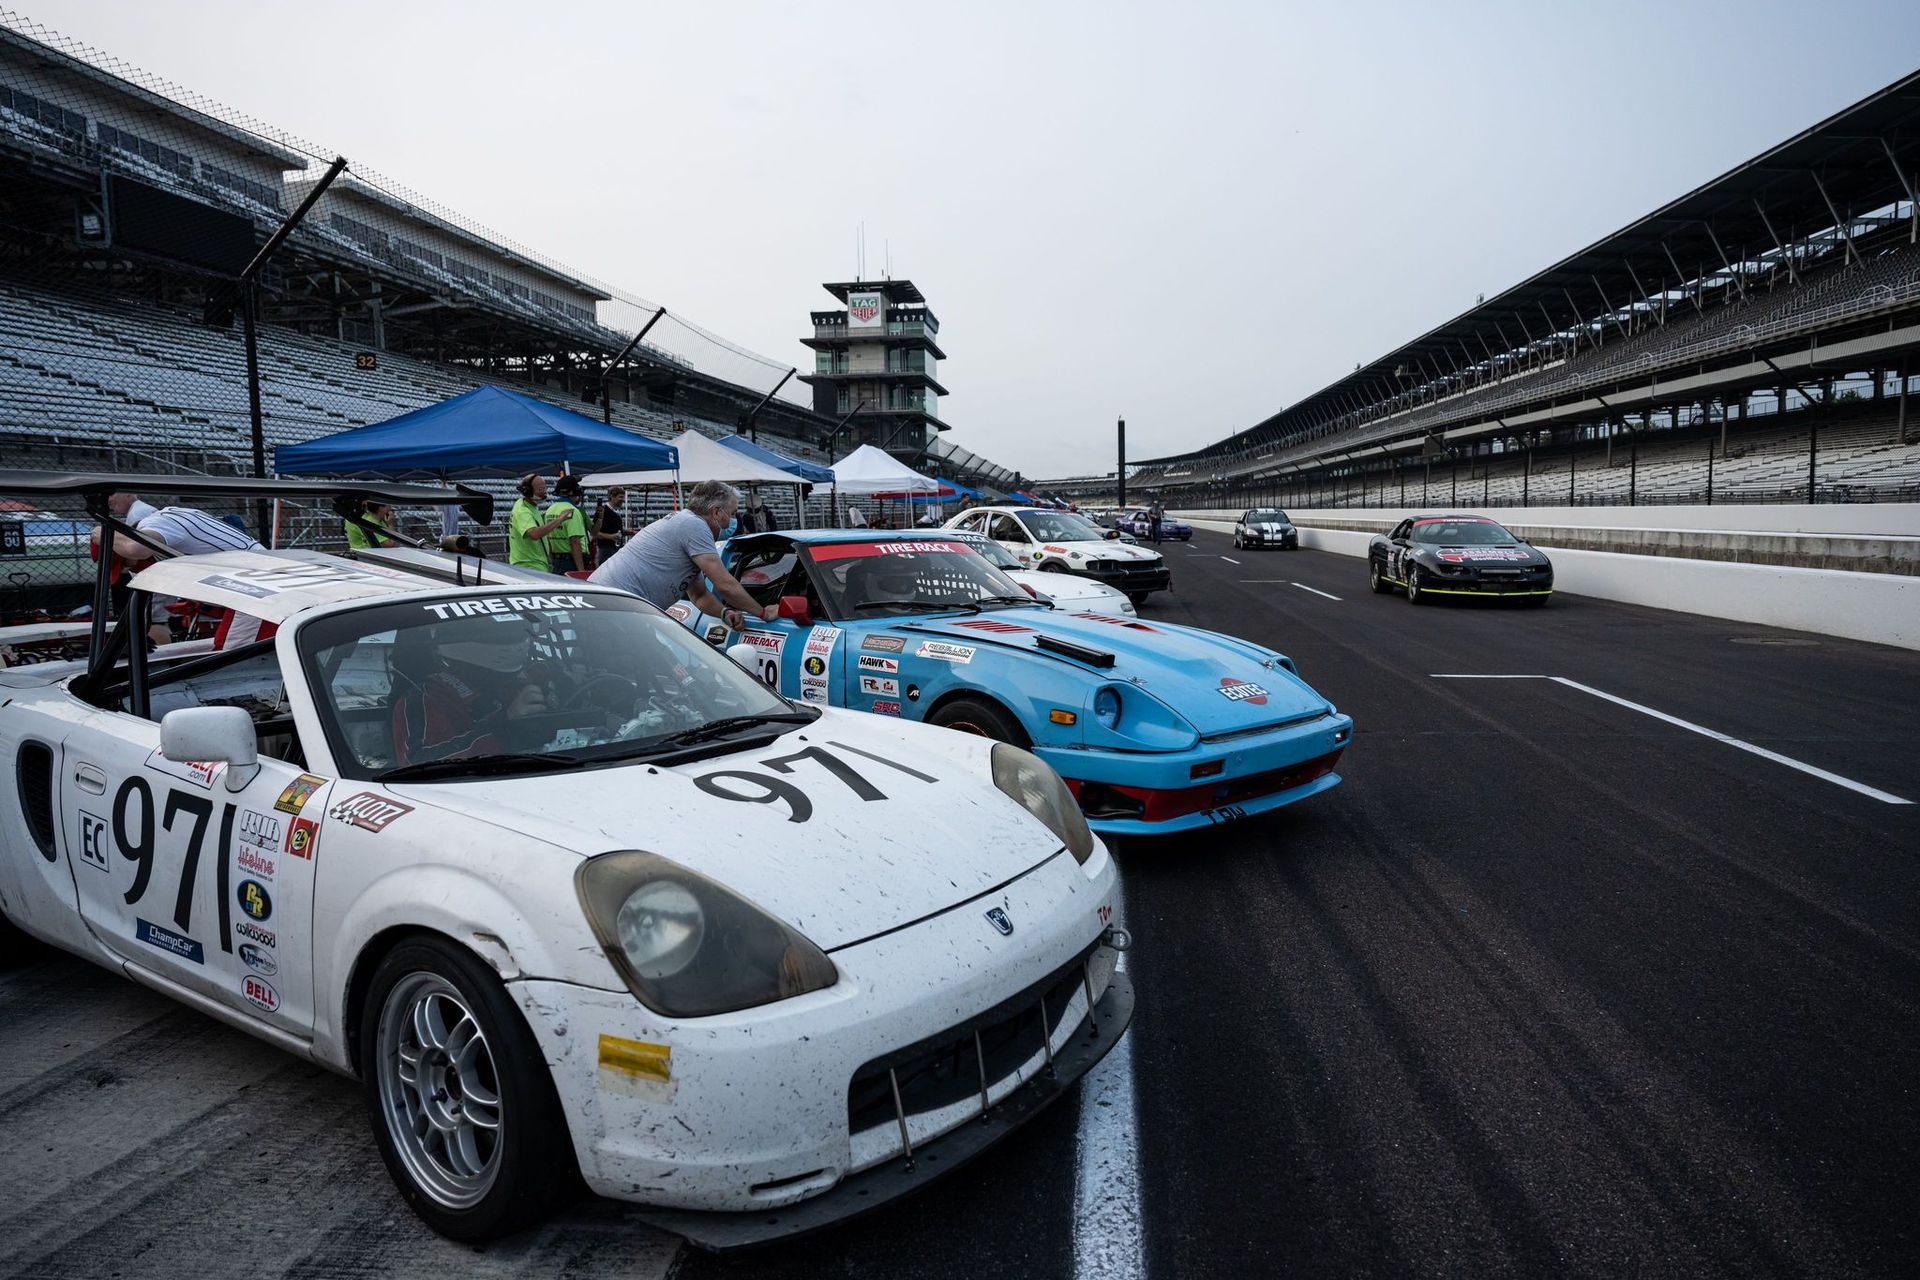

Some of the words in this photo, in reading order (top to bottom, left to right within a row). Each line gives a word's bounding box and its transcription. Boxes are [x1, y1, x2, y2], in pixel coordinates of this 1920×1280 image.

[852, 299, 877, 308] TAG
[852, 308, 877, 320] HEUER
[358, 355, 375, 367] 32
[874, 542, 915, 554] TIRE
[913, 542, 955, 553] RACK
[424, 598, 511, 619] TIRE
[507, 595, 596, 611] RACK
[743, 635, 760, 645] TIRE
[758, 637, 780, 653] RACK
[860, 657, 885, 668] HAWK
[1219, 683, 1268, 700] ECOTEC
[693, 741, 940, 823] 971
[341, 795, 405, 825] KLOTZ
[1200, 805, 1248, 824] TOW
[83, 816, 105, 864] EC
[112, 775, 237, 954] 971
[238, 845, 274, 875] lifeline
[149, 925, 193, 952] ChampCar
[236, 922, 276, 948] wilwood
[246, 979, 275, 1006] BELL
